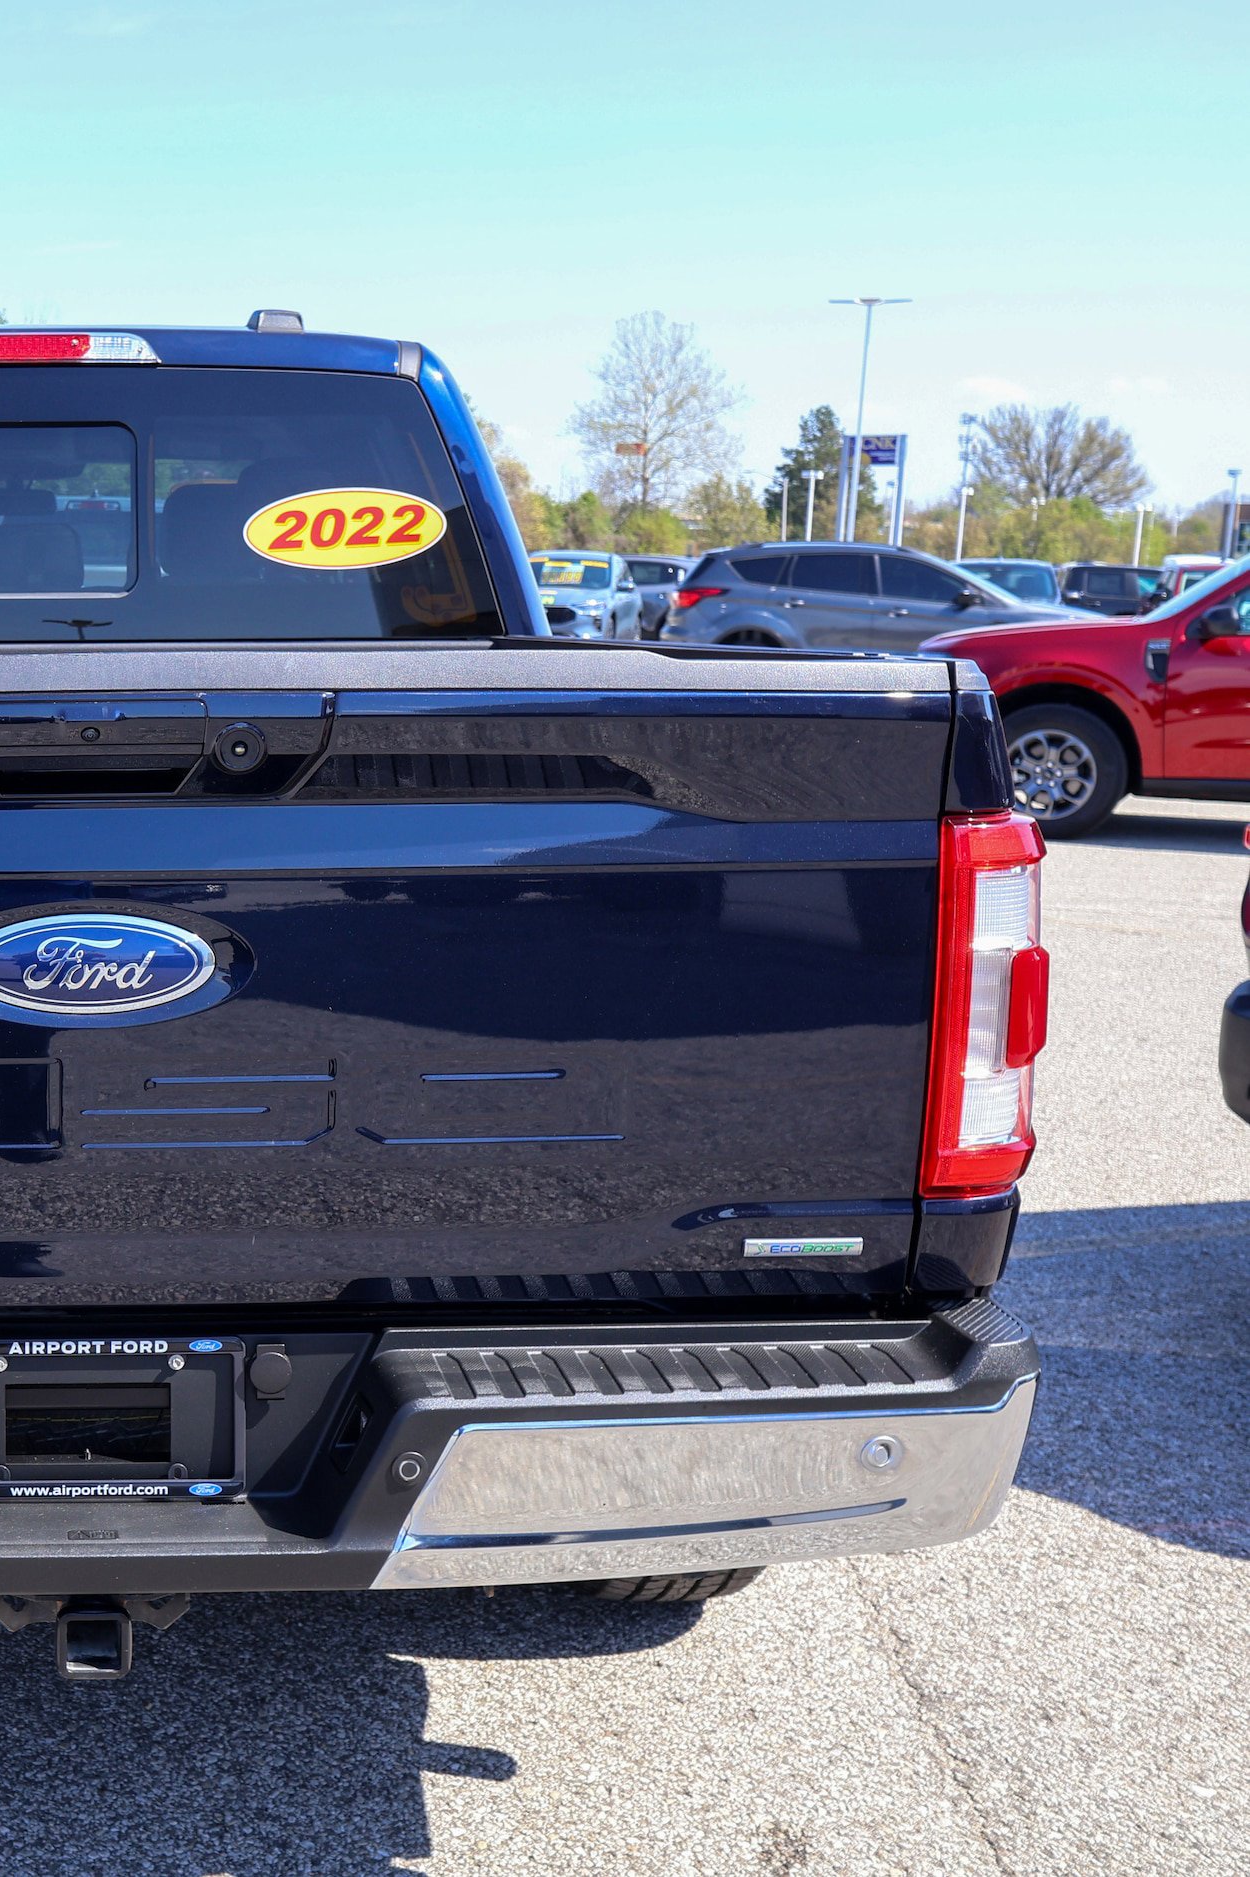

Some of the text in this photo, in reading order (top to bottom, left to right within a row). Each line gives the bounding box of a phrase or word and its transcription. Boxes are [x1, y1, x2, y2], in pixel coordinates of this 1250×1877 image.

[268, 504, 427, 551] 2022
[23, 936, 156, 990] Ford
[9, 1340, 168, 1354] AIRPORT FORD
[10, 1484, 168, 1498] www.airportford.com
